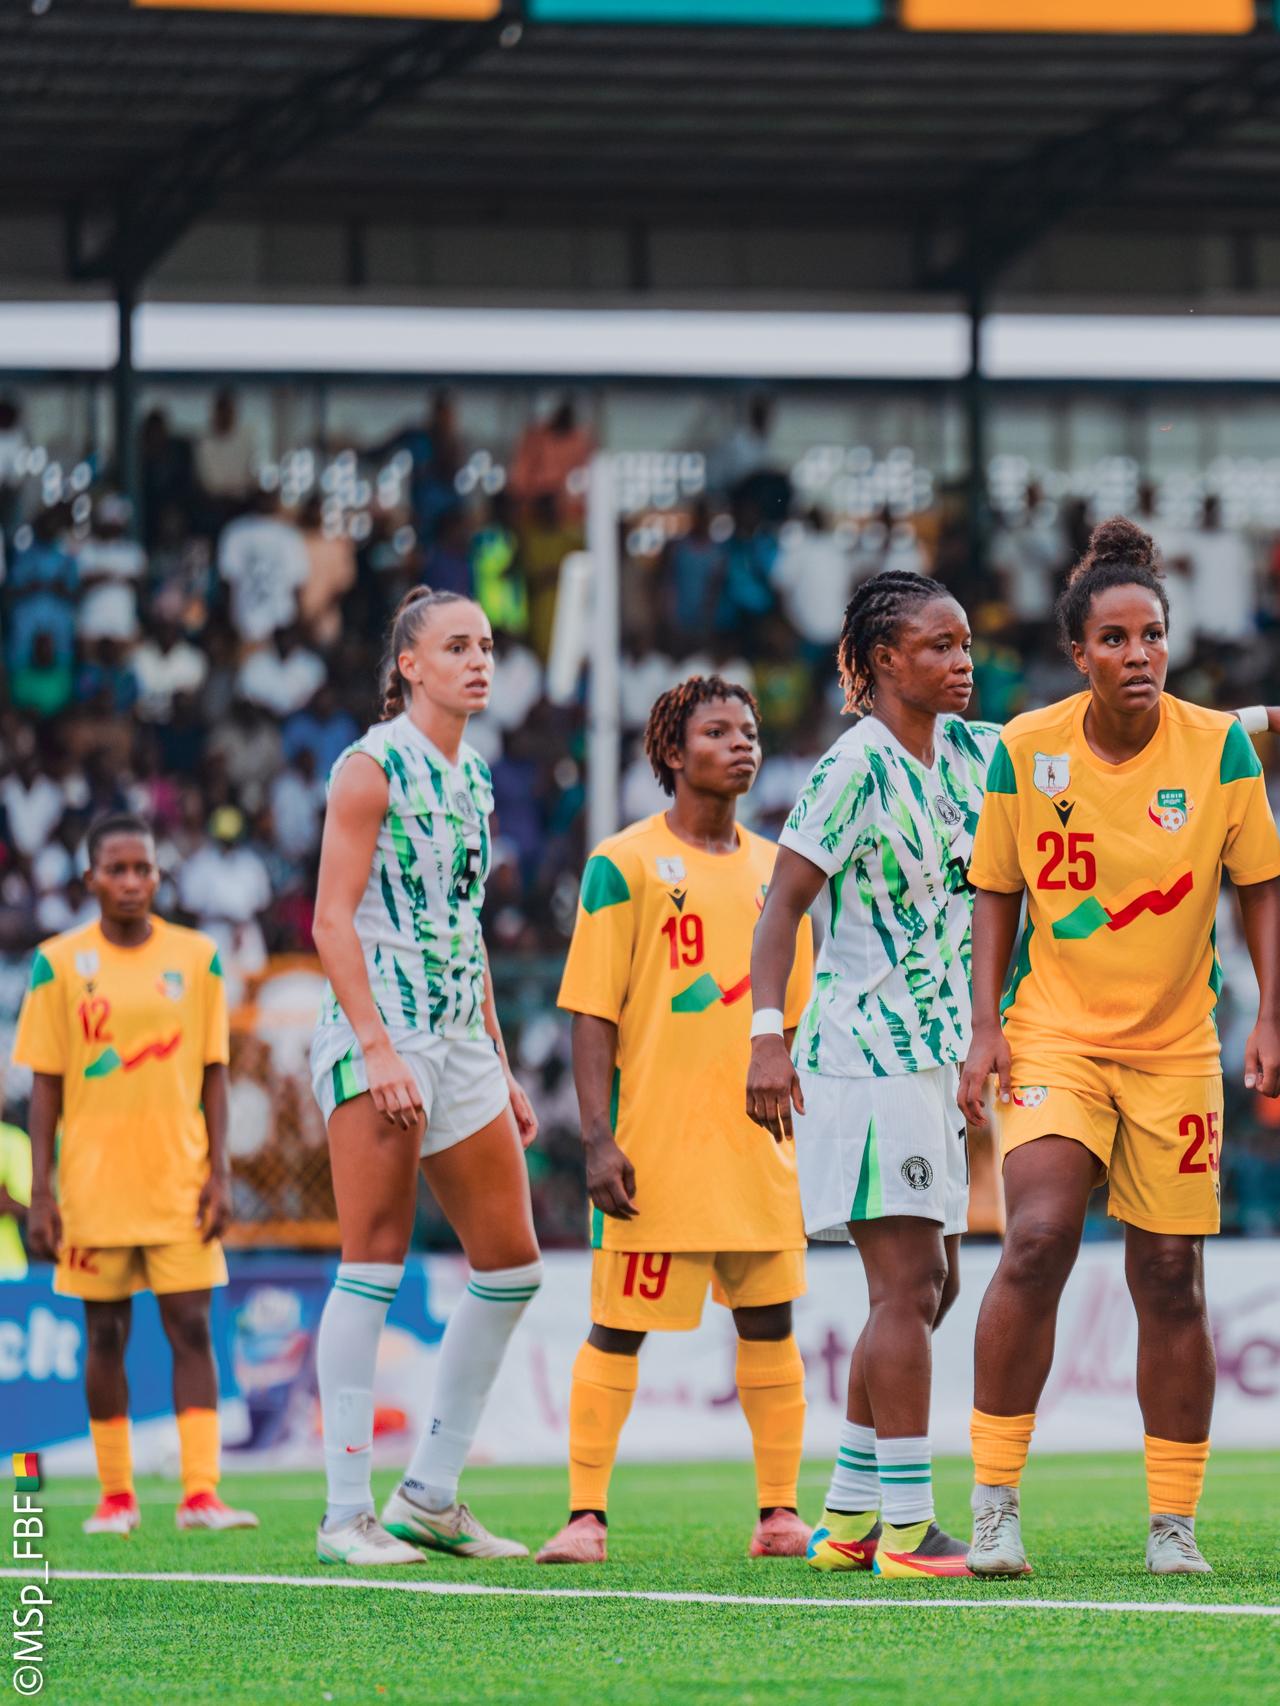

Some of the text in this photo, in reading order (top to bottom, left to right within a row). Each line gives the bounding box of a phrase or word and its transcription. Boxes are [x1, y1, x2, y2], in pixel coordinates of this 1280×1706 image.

[457, 848, 481, 900] 5
[1036, 831, 1097, 891] 25
[661, 913, 705, 970] 19
[78, 998, 113, 1043] 12
[1178, 1111, 1220, 1174] 25
[621, 1251, 672, 1300] 19
